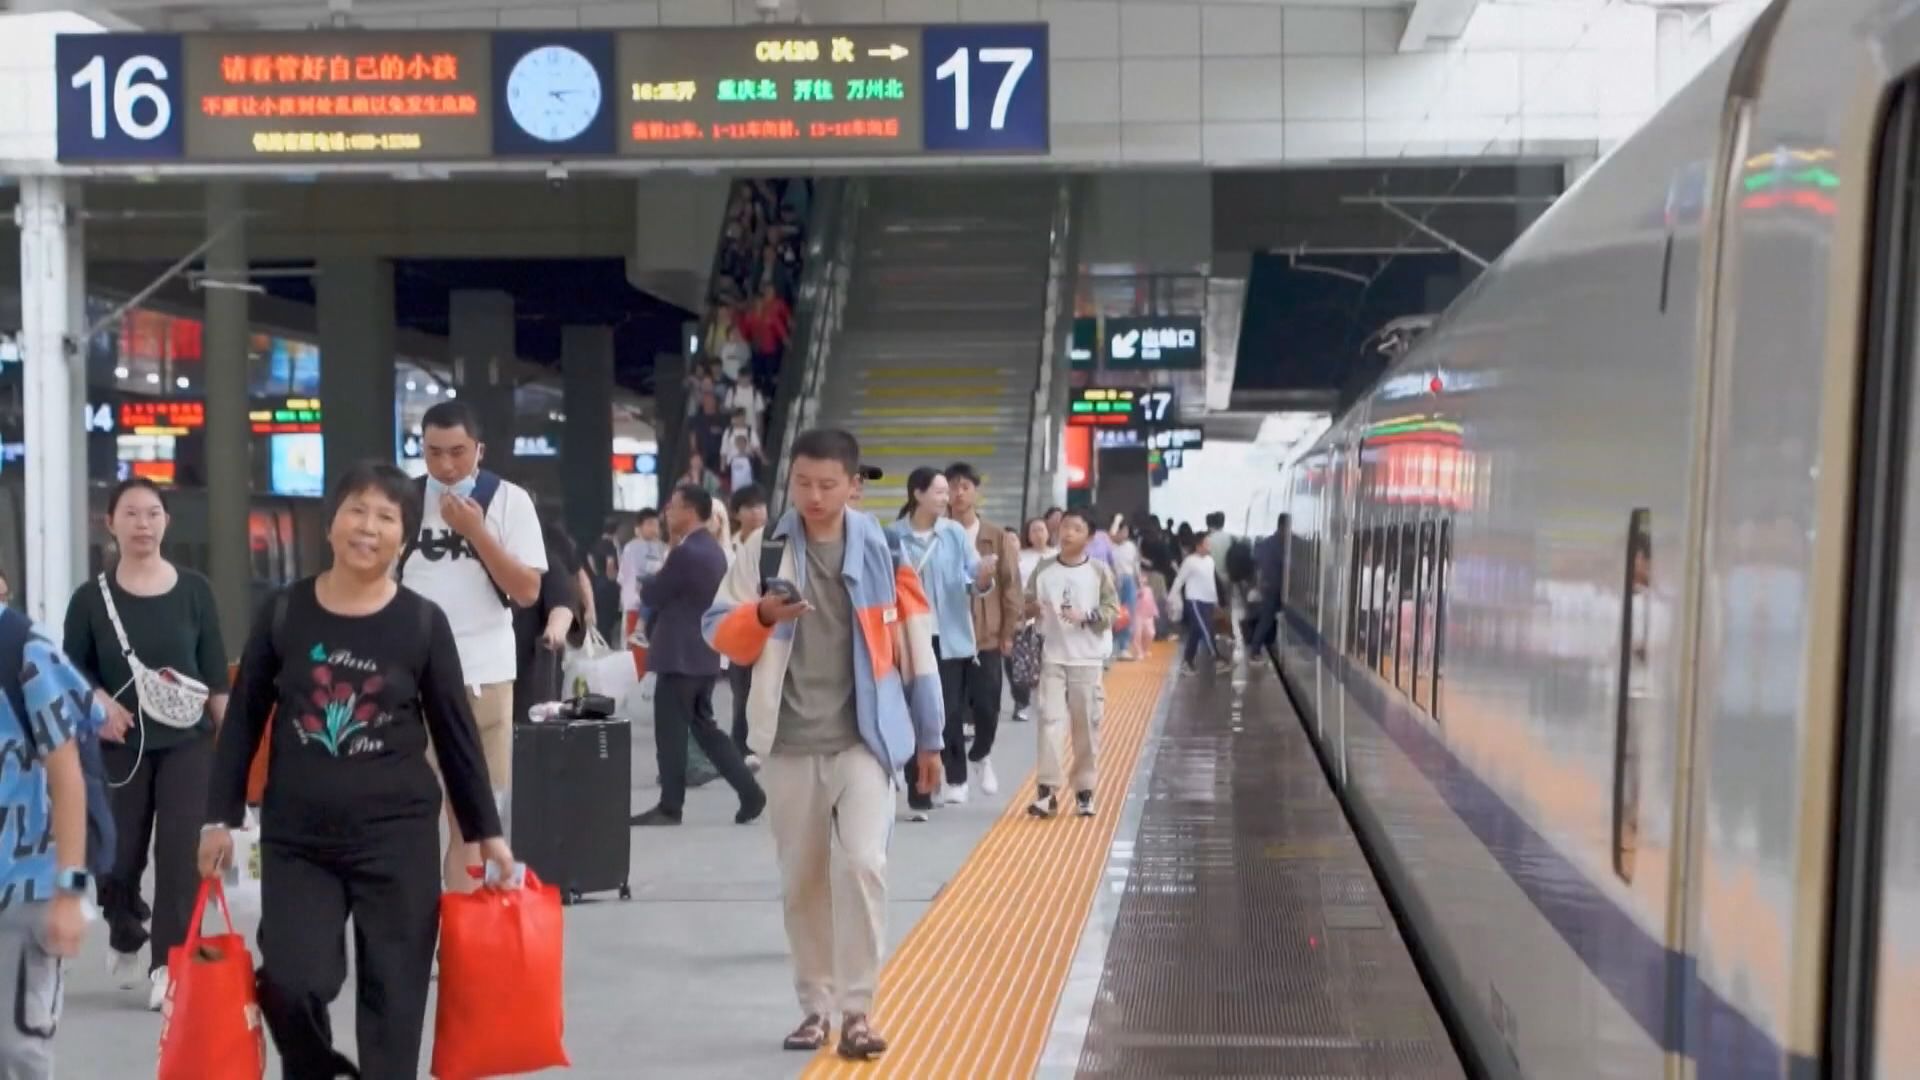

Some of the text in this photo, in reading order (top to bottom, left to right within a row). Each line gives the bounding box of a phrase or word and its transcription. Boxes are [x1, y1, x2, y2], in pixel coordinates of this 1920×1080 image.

[831, 36, 855, 62] 次
[221, 54, 458, 82] 请看管好自己的小孩
[70, 54, 171, 141] 16
[717, 78, 777, 101] 重庆北
[793, 78, 834, 101] 开往
[846, 77, 905, 101] 万州北
[935, 46, 1034, 132] 17
[1139, 391, 1171, 421] 17
